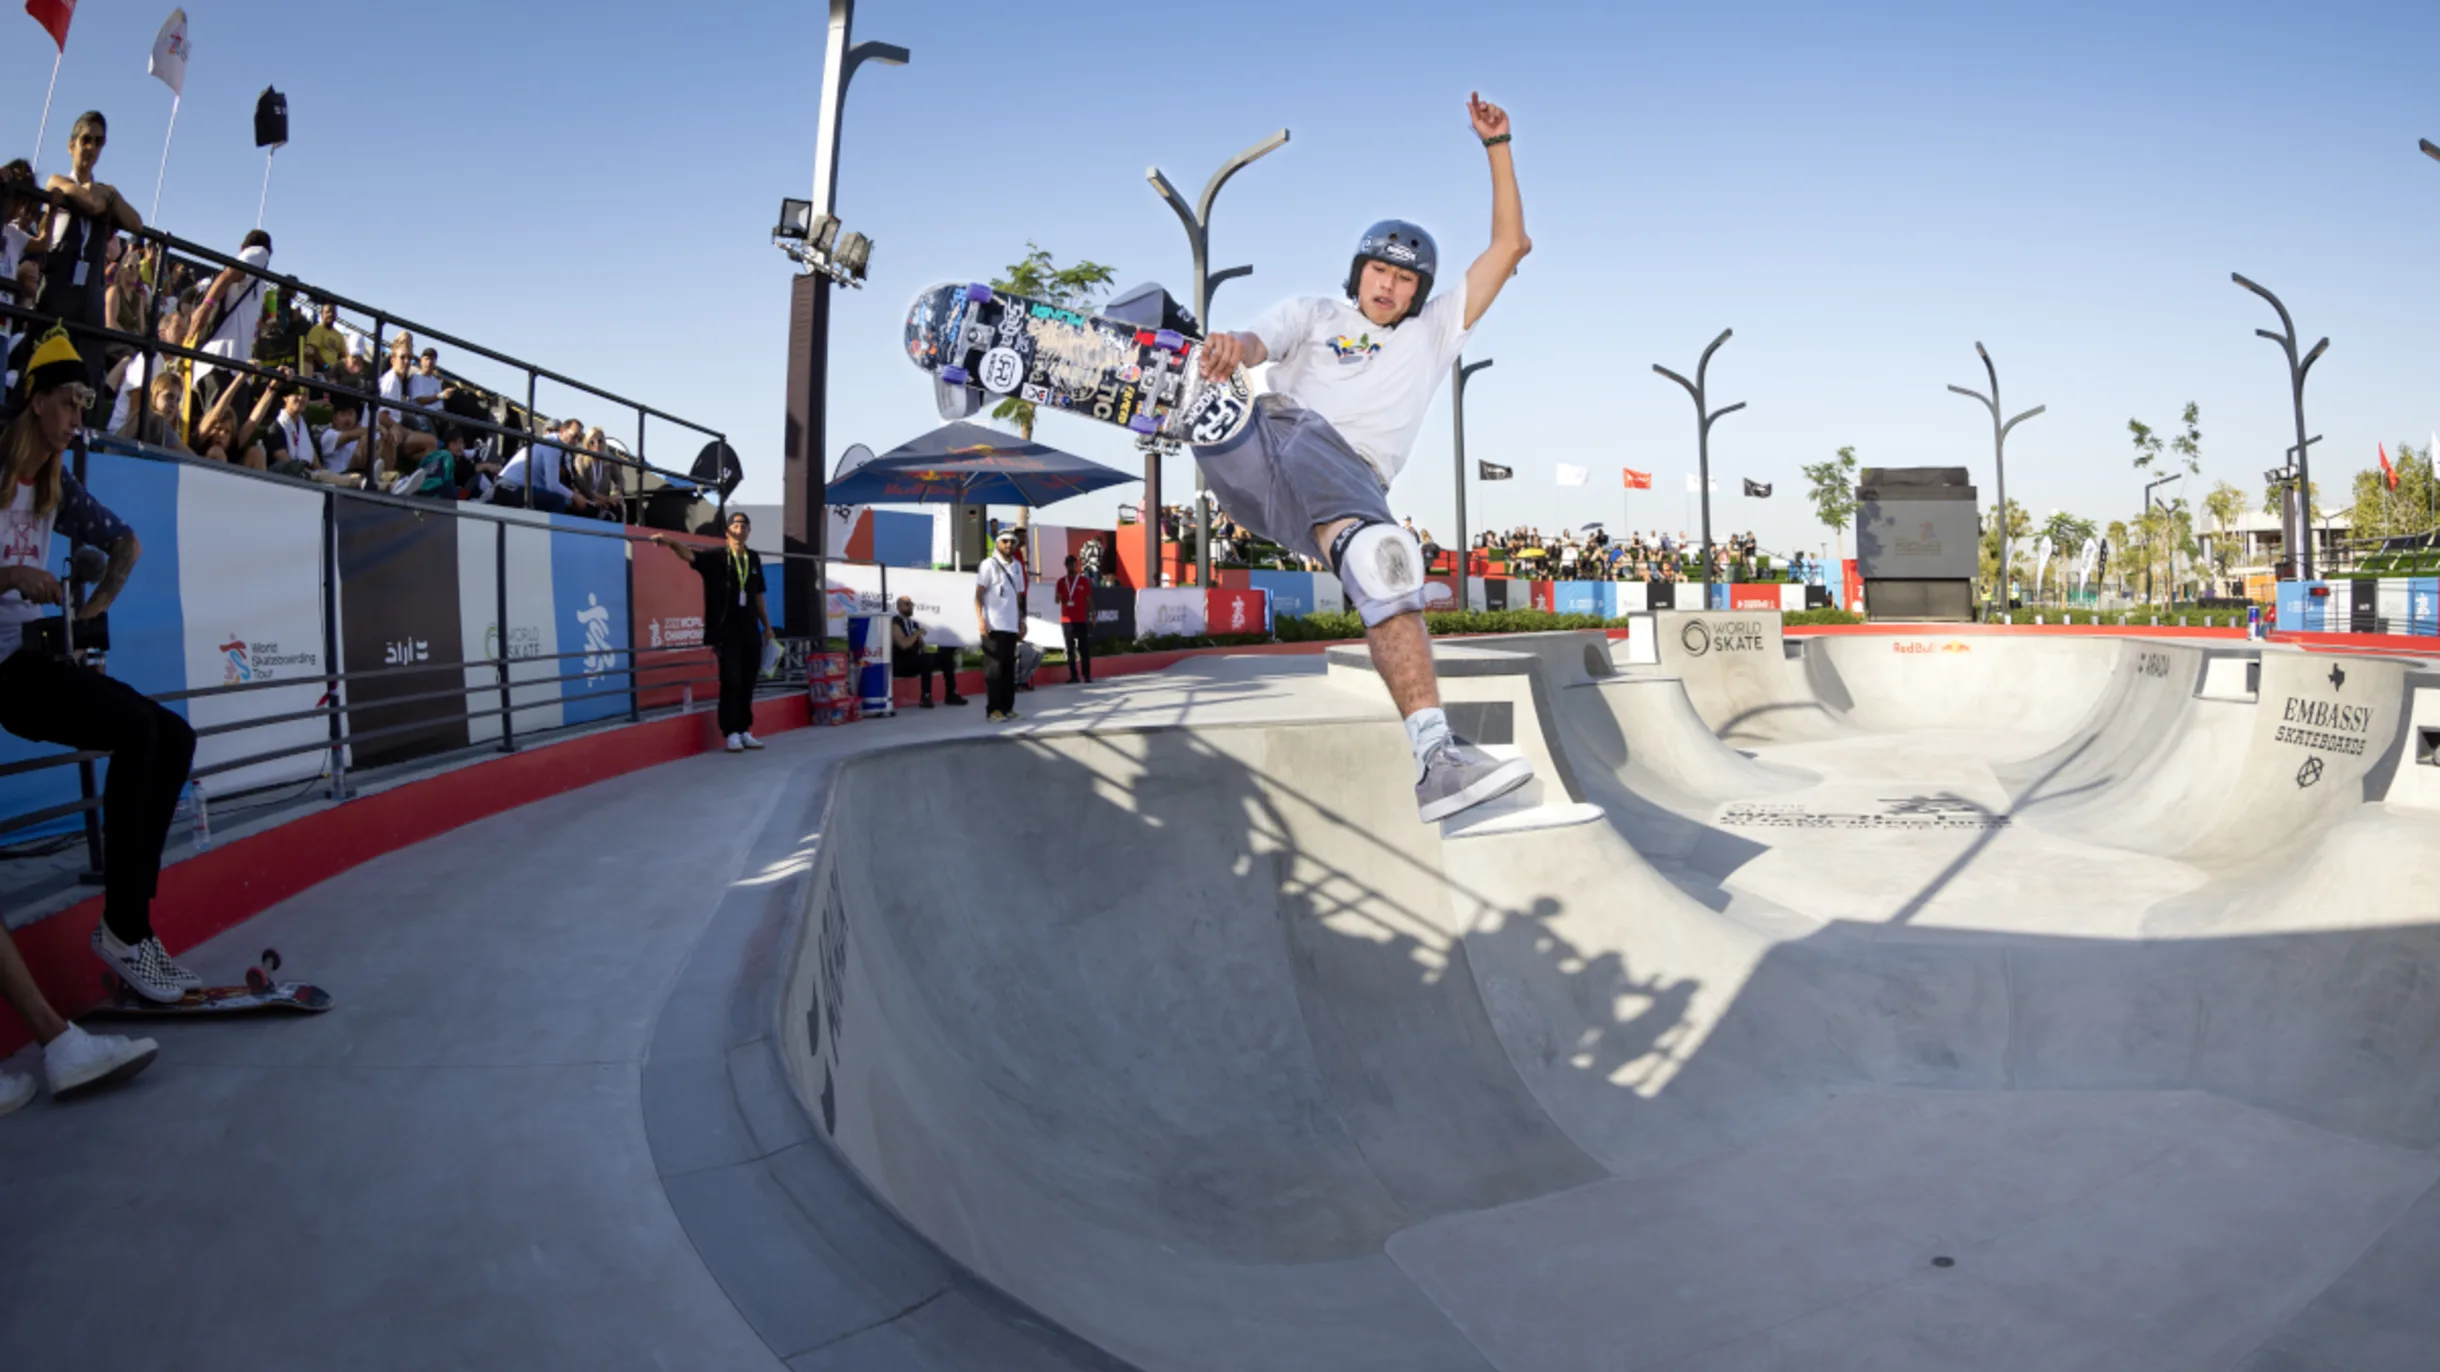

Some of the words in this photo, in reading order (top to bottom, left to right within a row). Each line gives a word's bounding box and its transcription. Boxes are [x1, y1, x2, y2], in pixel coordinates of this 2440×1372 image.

[1712, 620, 1762, 635] WORLD
[251, 641, 278, 654] World
[1714, 635, 1764, 652] SKATE
[251, 652, 316, 667] Skateboarding
[252, 668, 275, 680] Tour
[2283, 696, 2375, 733] EMBASSY
[2274, 725, 2367, 756] SKATEBOARDS
